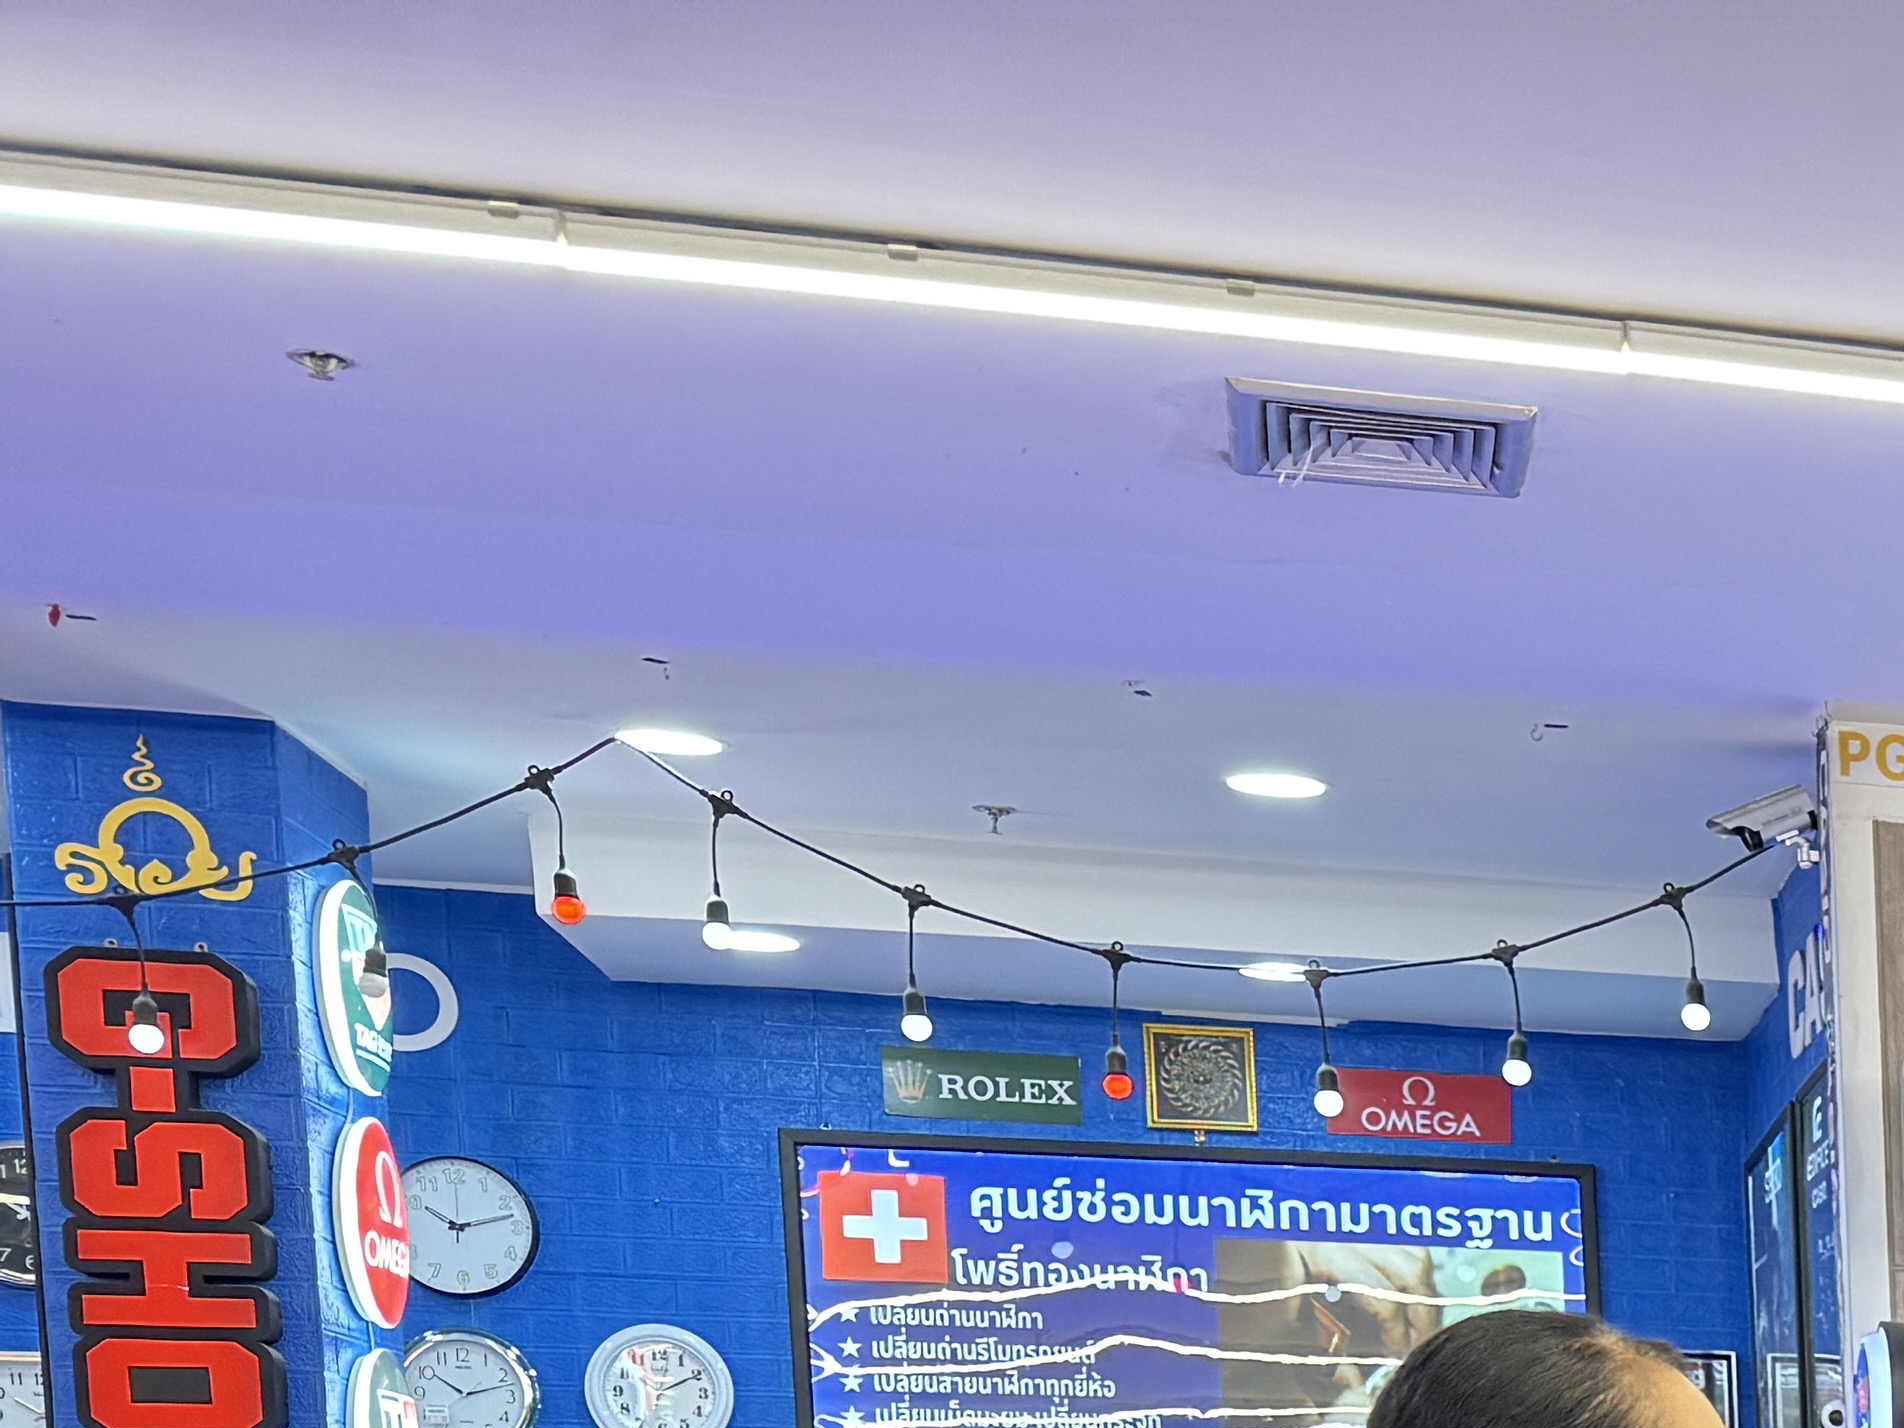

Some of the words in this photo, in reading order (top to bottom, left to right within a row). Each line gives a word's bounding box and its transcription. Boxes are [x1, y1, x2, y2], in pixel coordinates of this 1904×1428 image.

[937, 1073, 1078, 1106] ROLEX
[1360, 1105, 1482, 1138] OMEGA
[445, 1167, 467, 1186] 12
[969, 1176, 1553, 1249] ศูนย์ซ่อมนาฬิกามาตรฐาน
[869, 1304, 1043, 1331] เปลยนถ่านนาฬิกา
[455, 1347, 471, 1363] 12
[418, 1366, 436, 1380] 10
[498, 1367, 509, 1383] 2
[413, 1386, 426, 1402] 9
[505, 1388, 517, 1405] 3
[498, 1410, 510, 1424] 4
